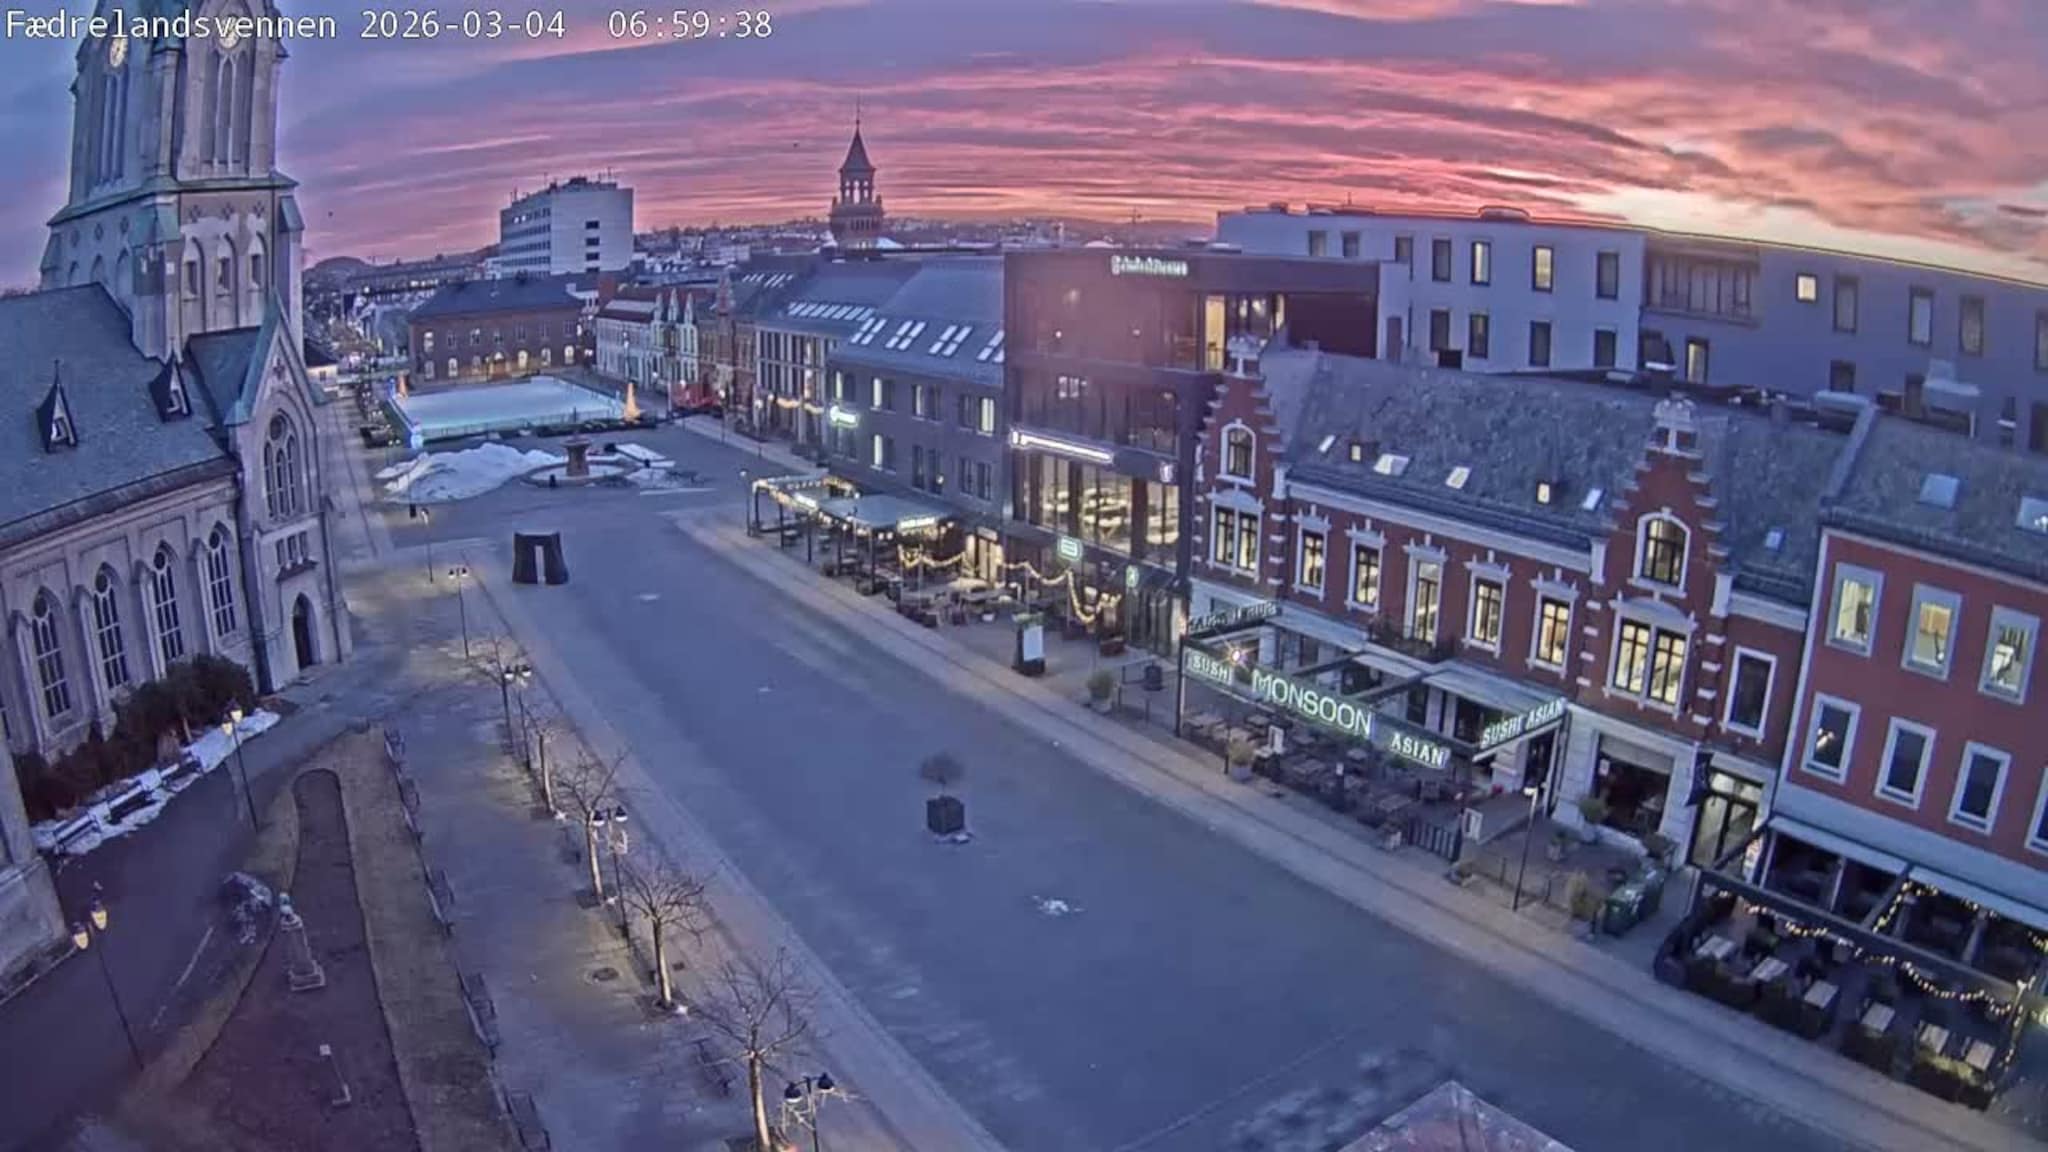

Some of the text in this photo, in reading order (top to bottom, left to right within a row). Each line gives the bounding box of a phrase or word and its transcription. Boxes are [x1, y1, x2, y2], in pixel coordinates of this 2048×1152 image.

[1252, 669, 1372, 738] MONSOON
[1481, 699, 1565, 747] SUSHI ASIAN
[1391, 732, 1445, 767] ASIAN
